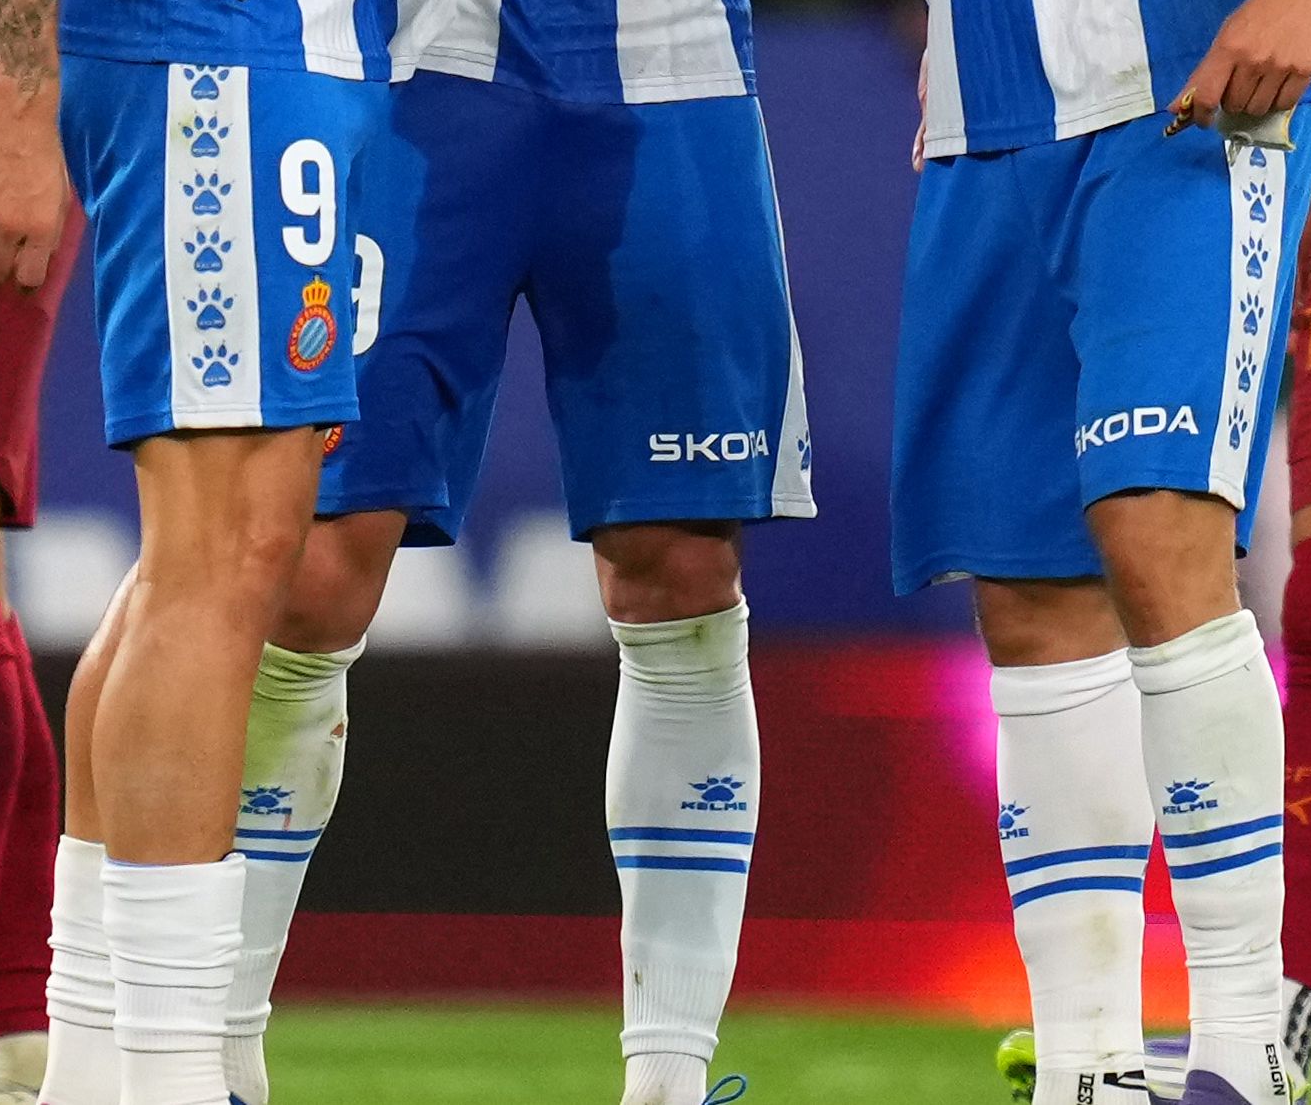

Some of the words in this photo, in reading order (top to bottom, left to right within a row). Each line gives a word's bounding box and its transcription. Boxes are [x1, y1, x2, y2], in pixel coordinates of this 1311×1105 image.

[280, 138, 335, 266] 9
[240, 805, 292, 815] ELME
[681, 801, 747, 811] KELME
[1162, 799, 1218, 815] KELME
[1265, 1043, 1286, 1096] ESIGN
